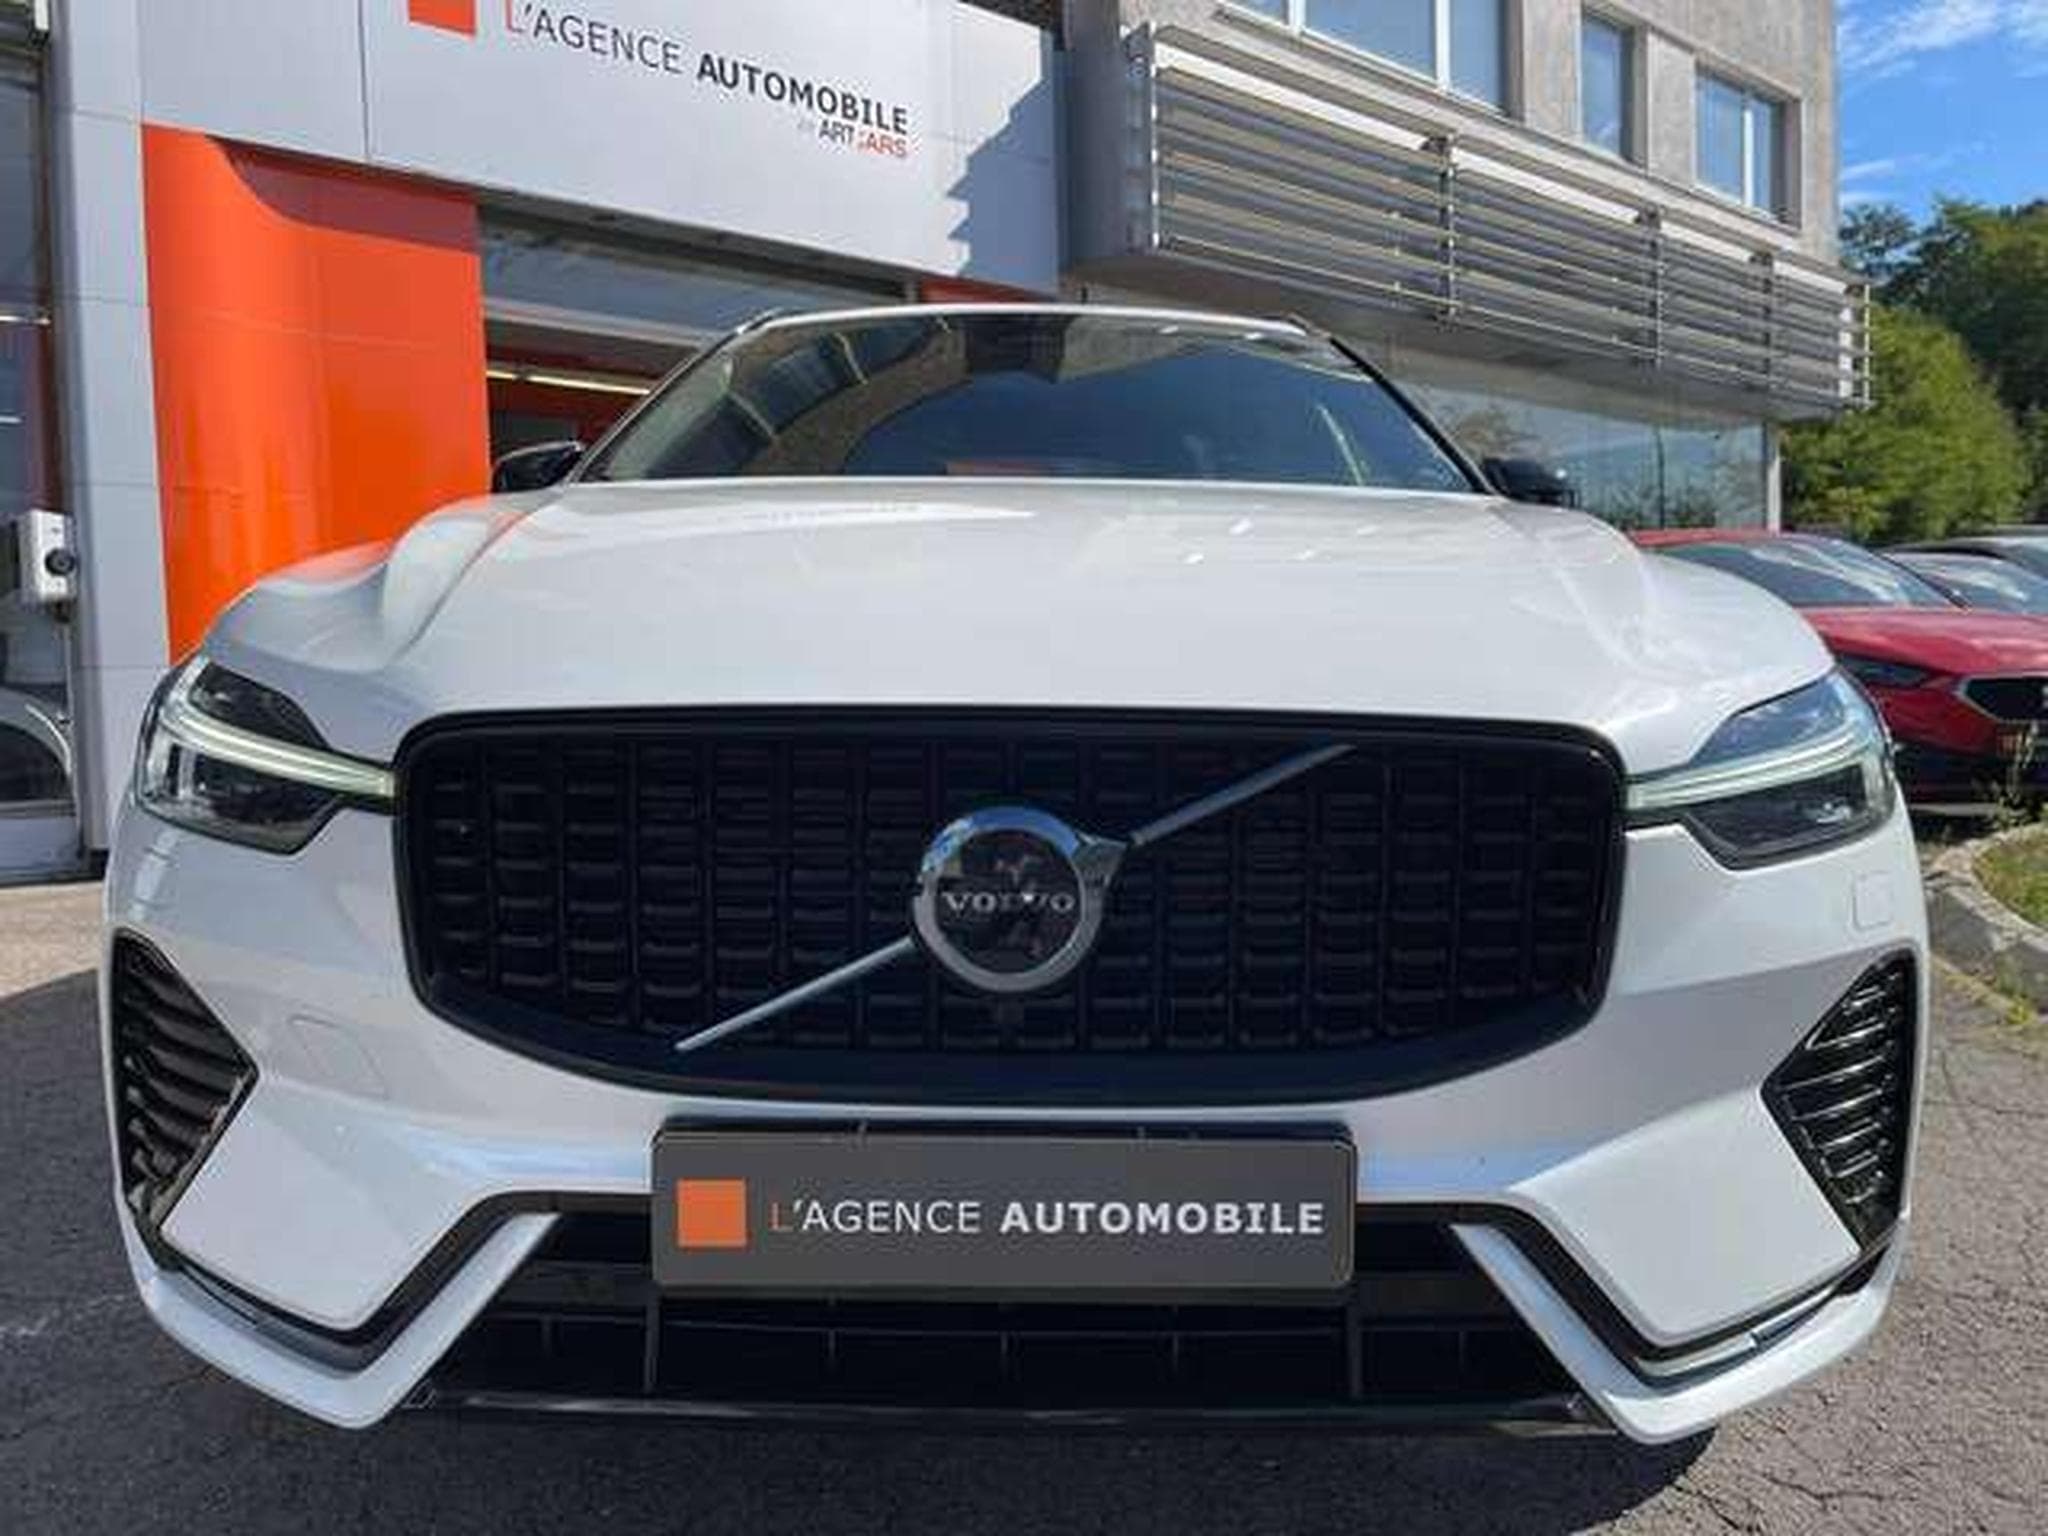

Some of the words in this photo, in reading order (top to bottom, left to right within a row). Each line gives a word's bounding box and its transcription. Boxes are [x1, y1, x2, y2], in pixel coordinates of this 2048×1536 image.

[505, 0, 683, 74] L'AGENCE
[697, 53, 907, 134] AUTOMOBILE
[769, 1199, 982, 1234] L'AGENCE
[1000, 1201, 1324, 1235] AUTOMOBILE
